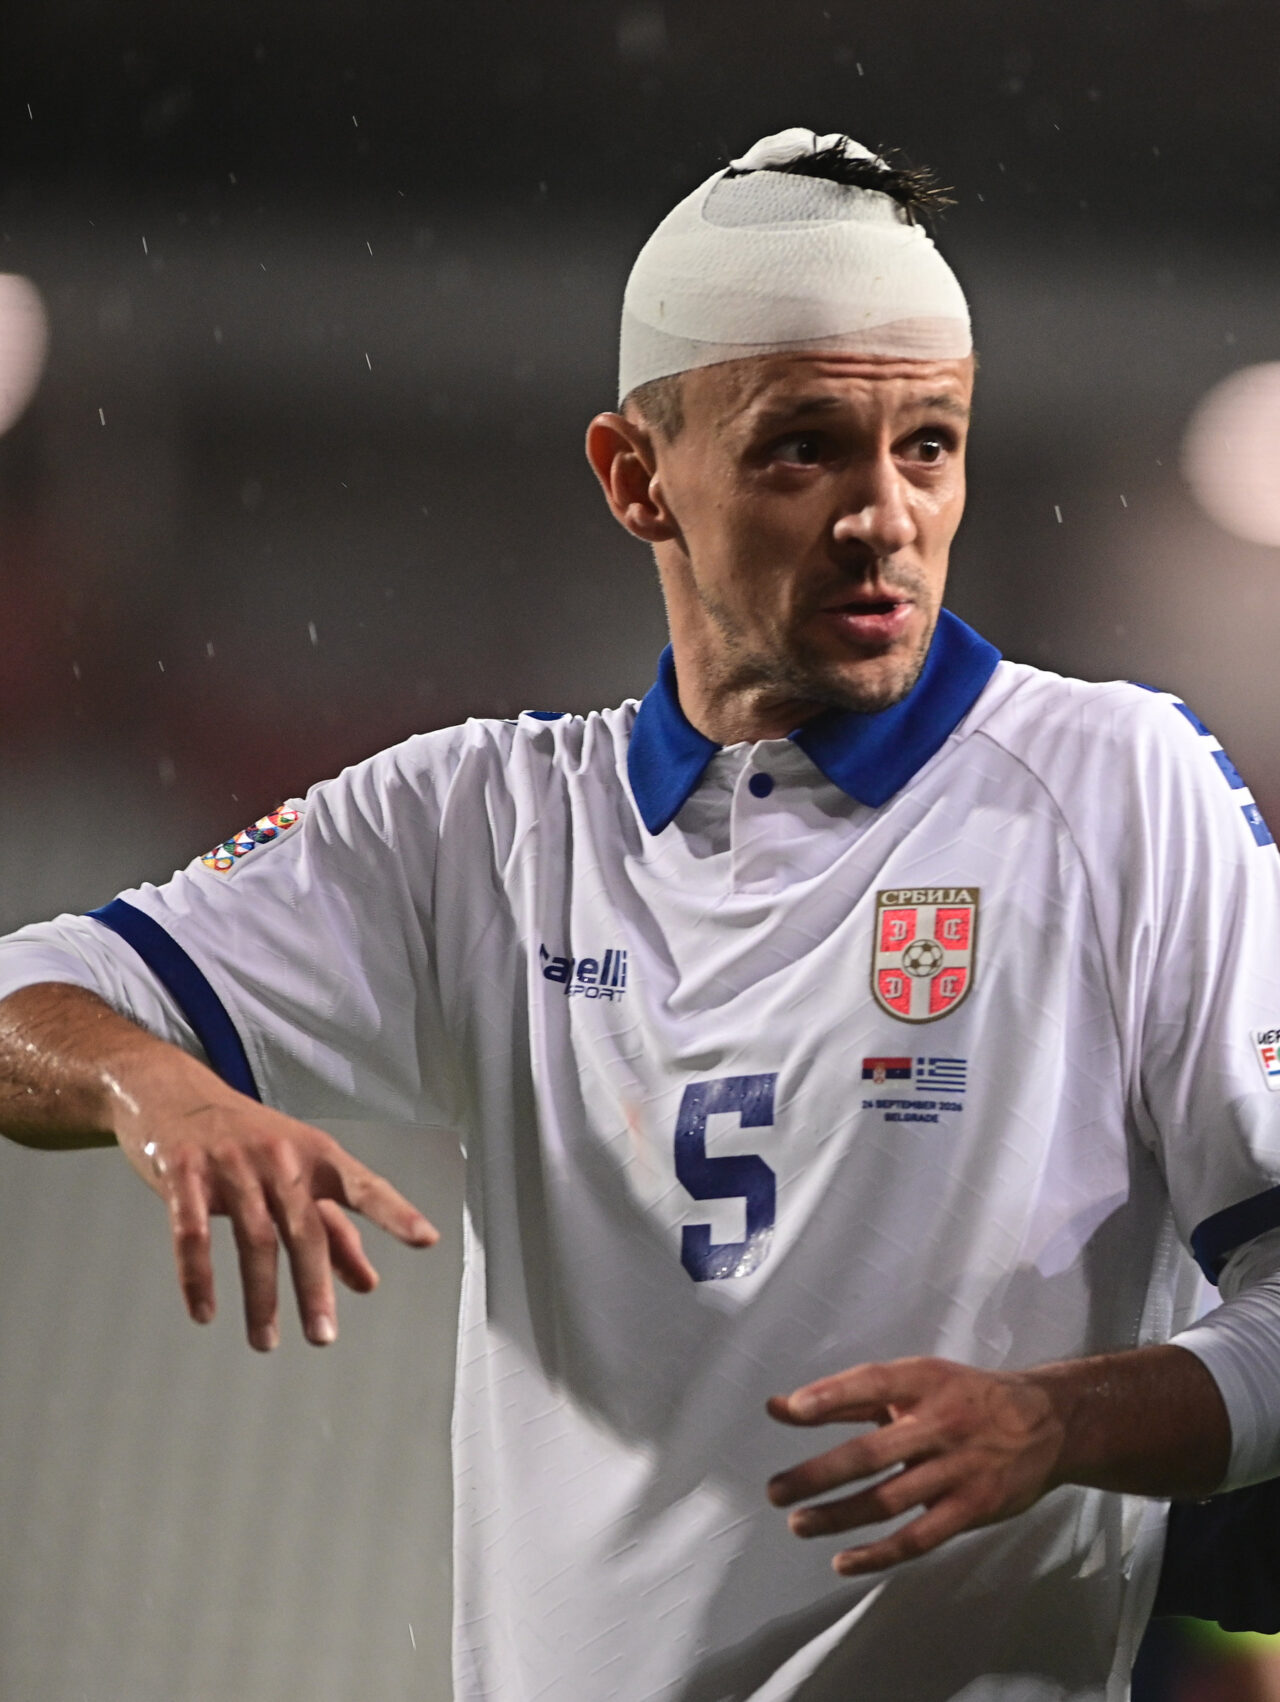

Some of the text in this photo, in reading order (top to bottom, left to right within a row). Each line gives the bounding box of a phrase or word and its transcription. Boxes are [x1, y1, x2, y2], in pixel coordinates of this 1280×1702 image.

[880, 888, 973, 905] СРБИЈА
[875, 1099, 936, 1110] SEPTEMBER
[884, 1112, 939, 1123] BELGRADE
[674, 1072, 779, 1283] 5
